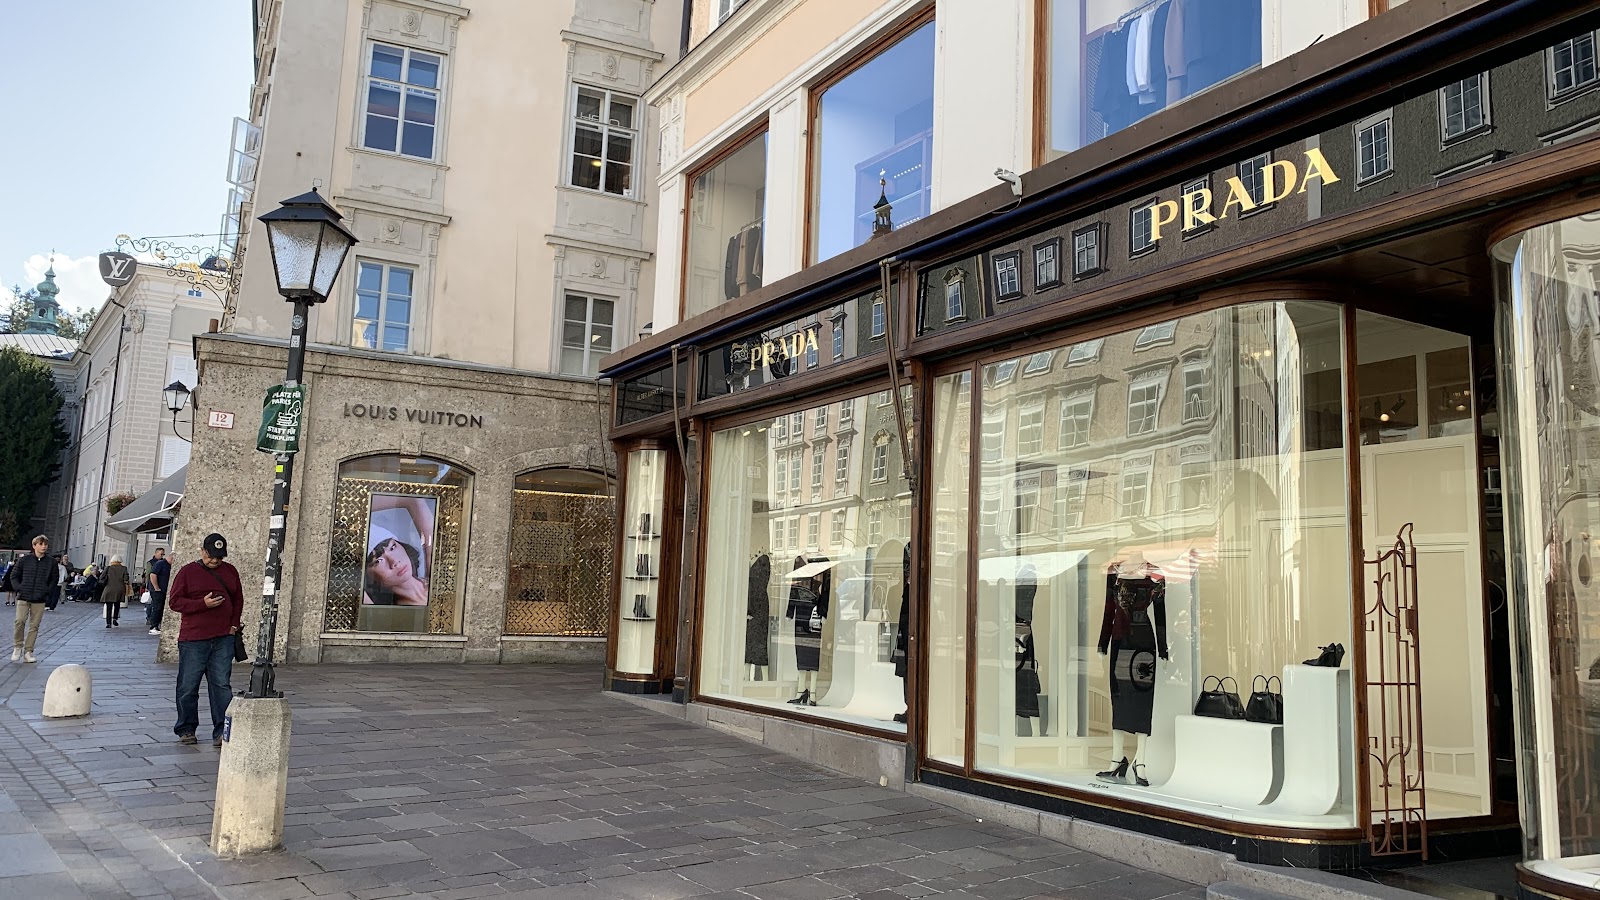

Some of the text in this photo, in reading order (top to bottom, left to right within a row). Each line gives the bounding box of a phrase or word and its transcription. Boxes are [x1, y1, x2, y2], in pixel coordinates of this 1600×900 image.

[1148, 147, 1341, 243] PRADA
[749, 328, 819, 371] PRADA
[215, 413, 228, 423] 12
[343, 402, 483, 428] LOUIS VUITTON
[267, 426, 287, 434] STATT
